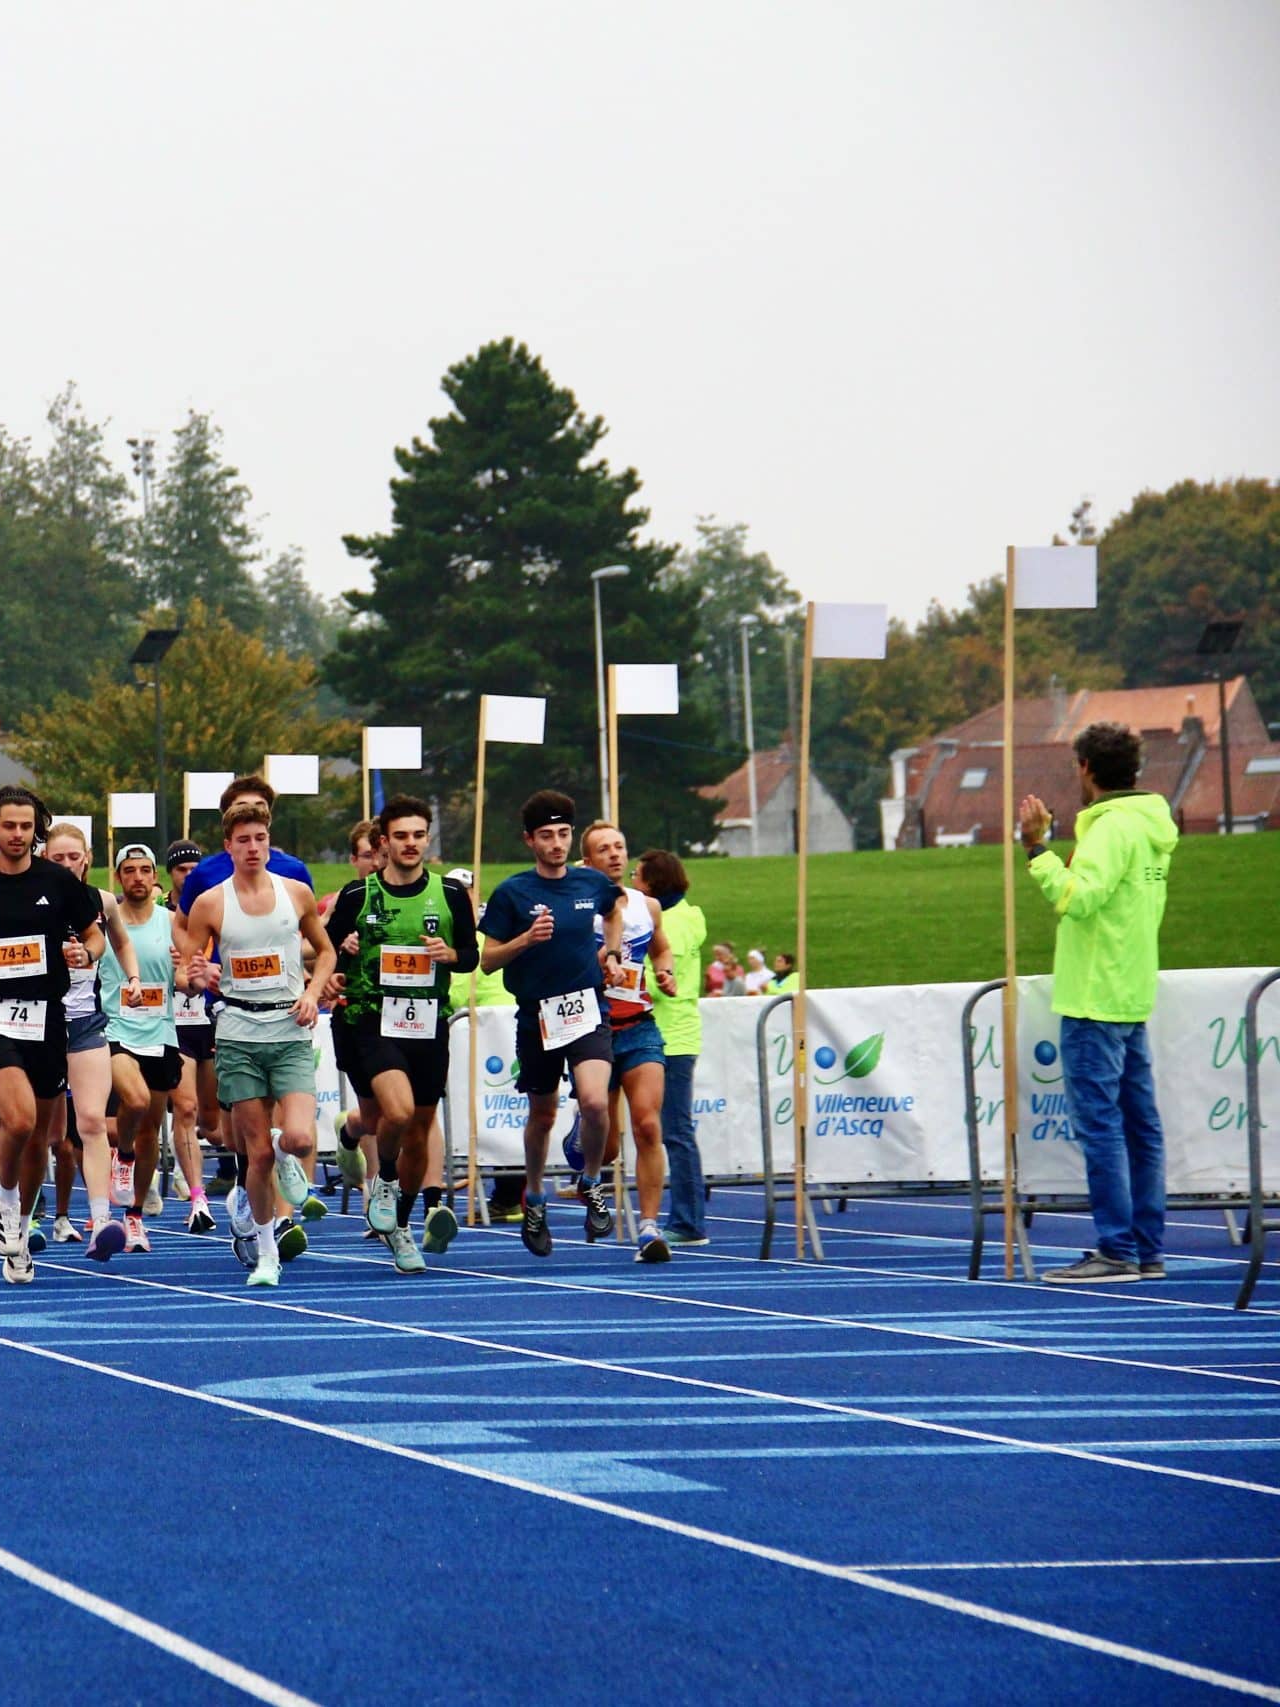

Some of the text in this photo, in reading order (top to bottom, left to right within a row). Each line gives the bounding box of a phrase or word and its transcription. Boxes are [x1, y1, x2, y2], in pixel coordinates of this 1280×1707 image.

[0, 945, 31, 960] 74-A
[235, 958, 273, 972] 316-A
[394, 955, 417, 968] 6-A
[10, 1006, 29, 1022] 74
[405, 1006, 416, 1021] 6
[557, 1000, 584, 1018] 423
[815, 1093, 914, 1114] Villeneuve
[816, 1117, 883, 1139] d'Ascq
